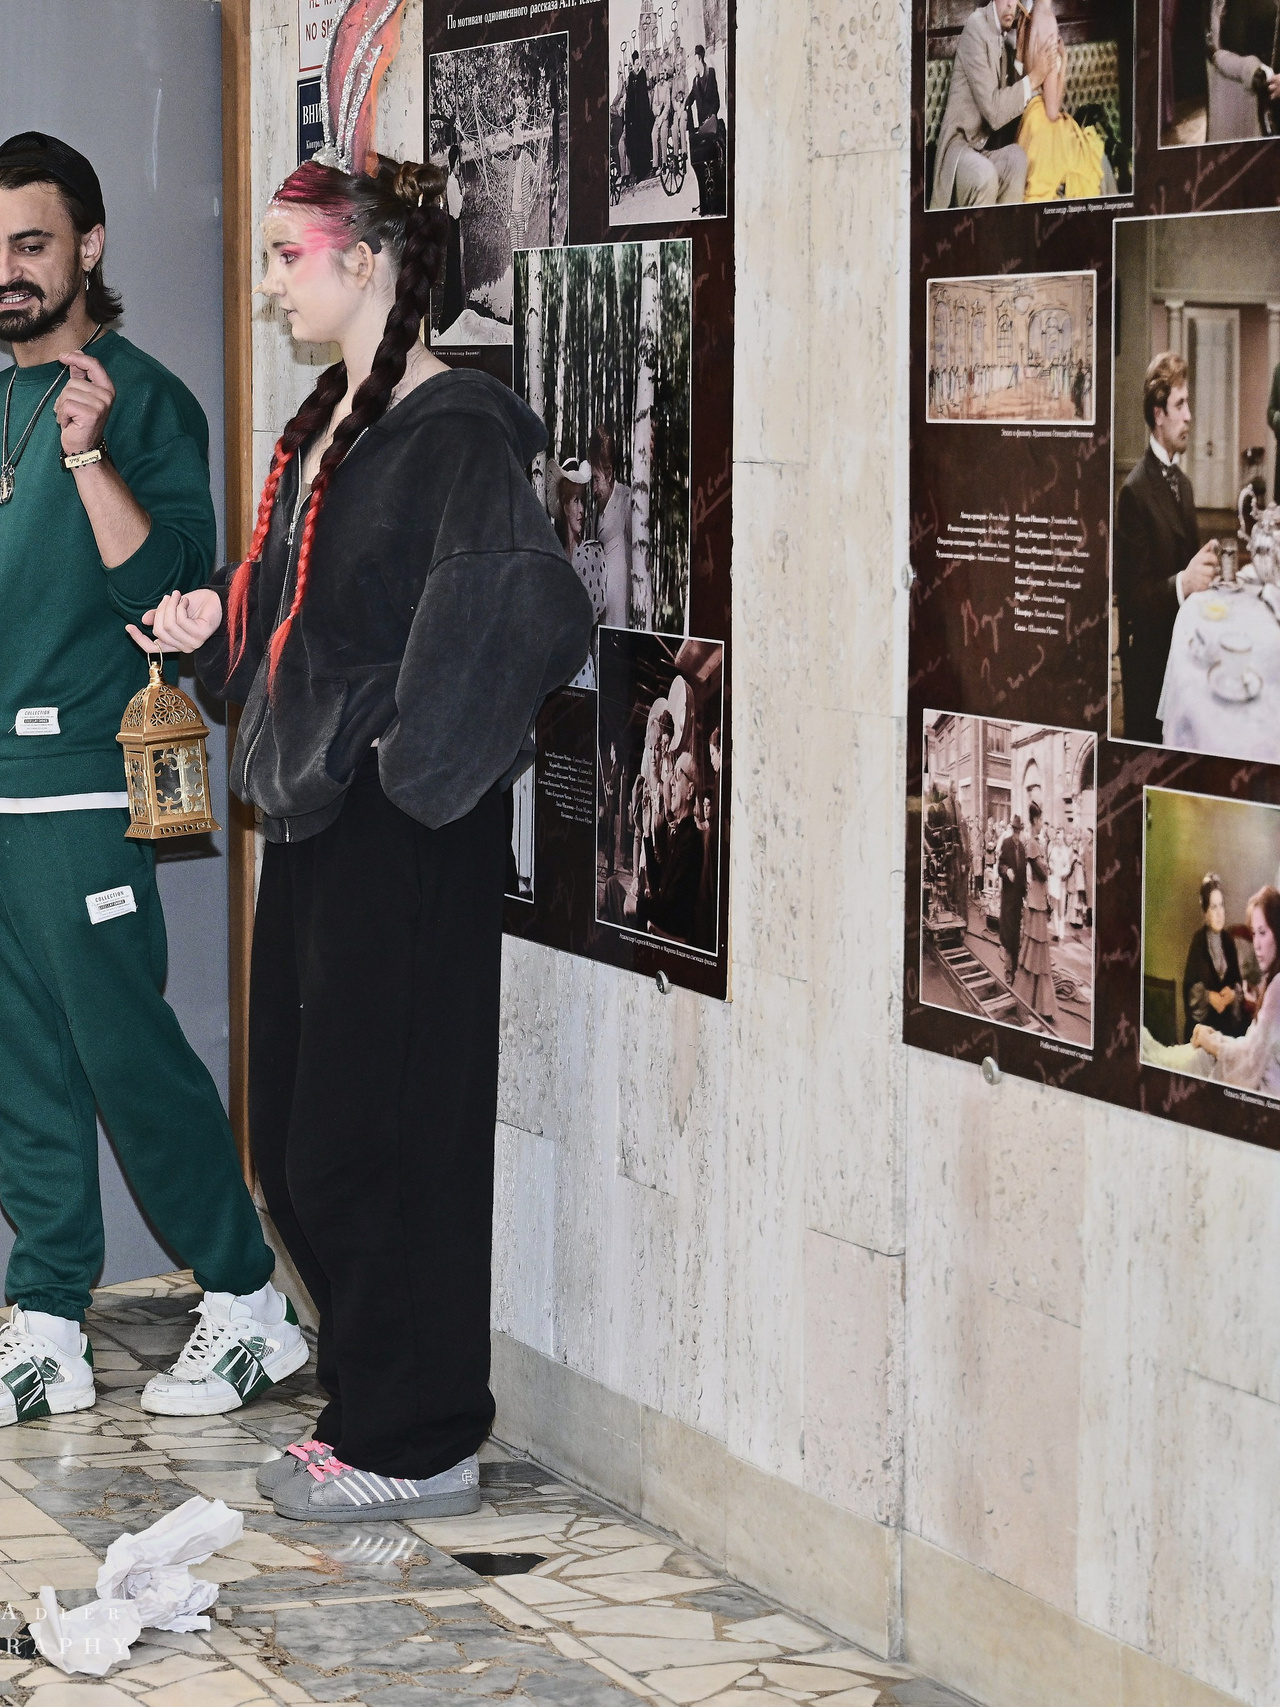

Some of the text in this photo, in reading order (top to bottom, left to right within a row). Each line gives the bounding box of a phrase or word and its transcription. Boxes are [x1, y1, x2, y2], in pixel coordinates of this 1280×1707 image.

[447, 14, 457, 30] По
[457, 16, 483, 29] мотивам
[484, 6, 528, 24] одноименного
[529, 2, 558, 18] рассказа
[305, 22, 318, 42] NO
[94, 890, 125, 903] COLLECTION
